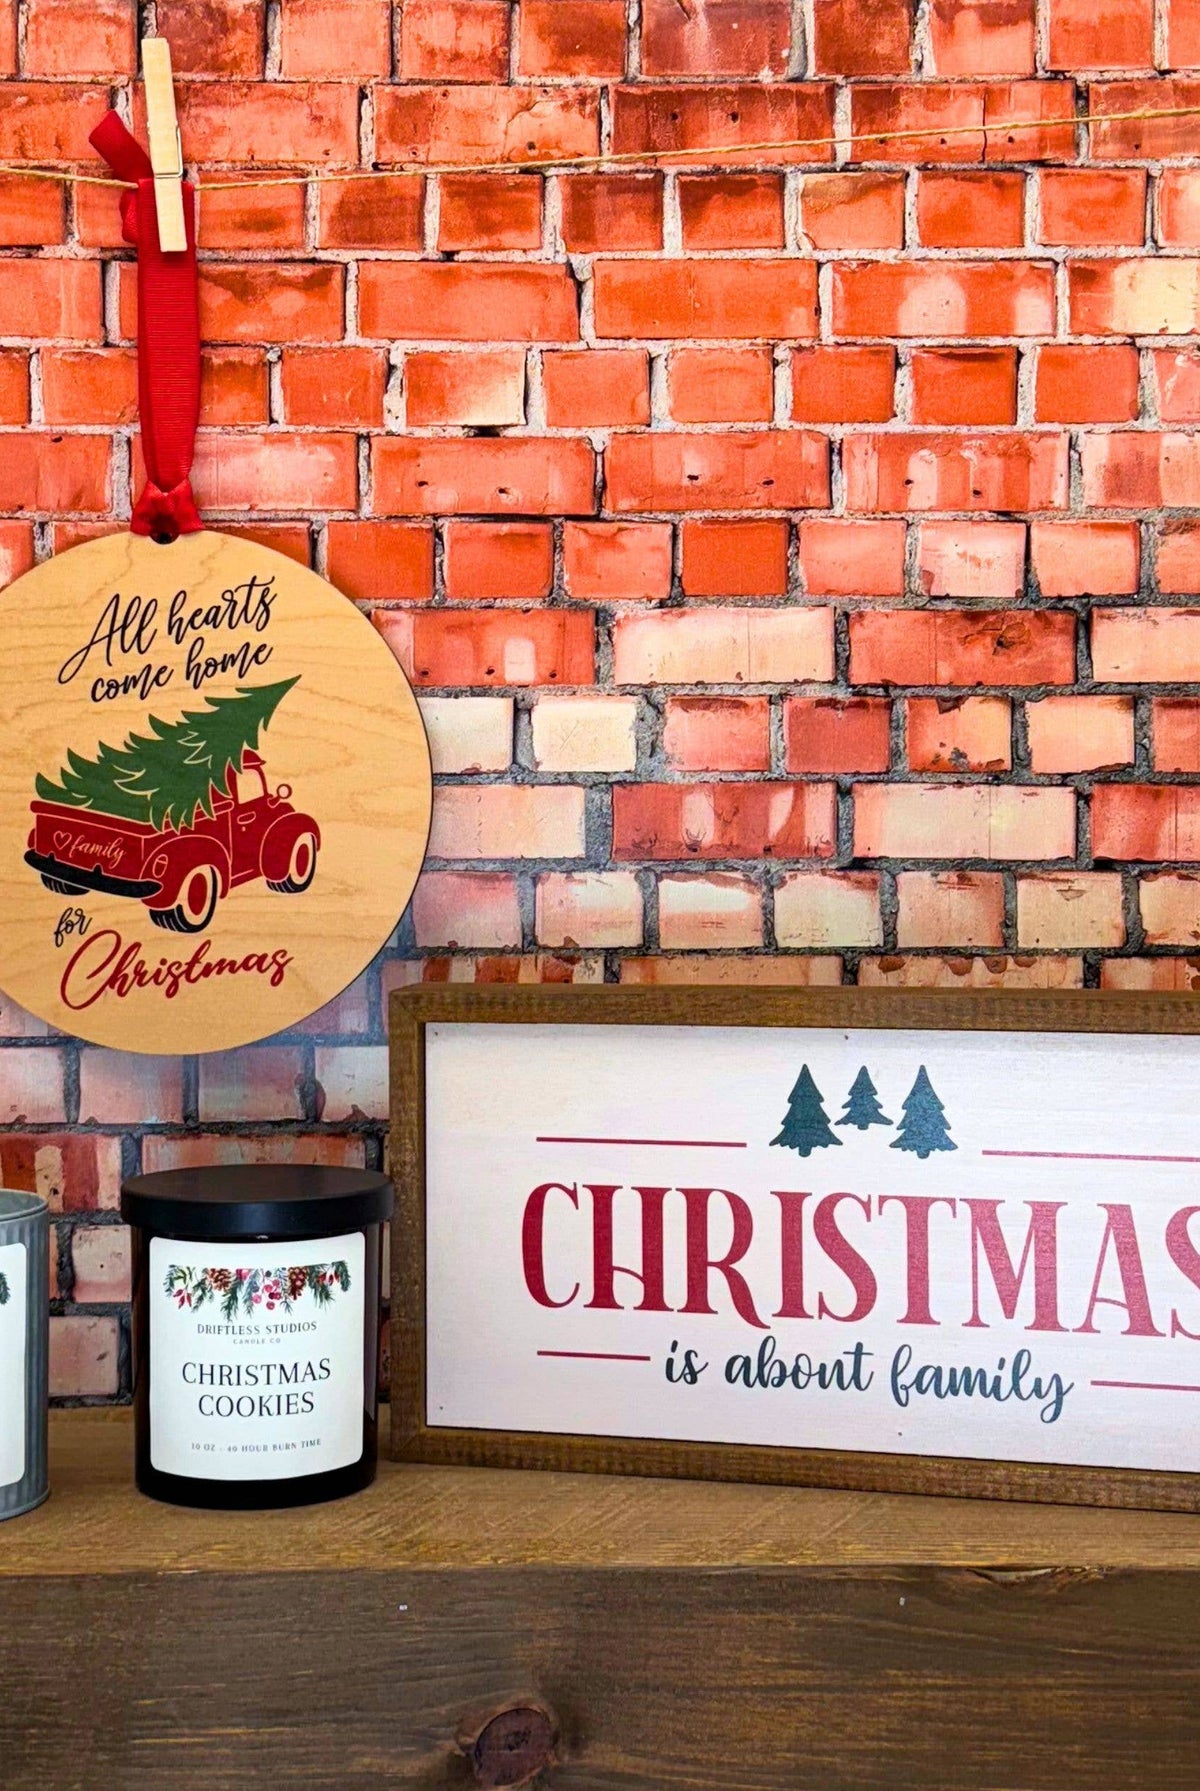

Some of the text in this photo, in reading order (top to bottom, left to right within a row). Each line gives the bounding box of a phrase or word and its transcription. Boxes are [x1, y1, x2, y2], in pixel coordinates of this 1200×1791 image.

[57, 575, 277, 685] All hearts
[90, 636, 274, 702] come home
[68, 834, 126, 869] family
[53, 907, 93, 948] for
[60, 929, 294, 1011] Christmas
[197, 1320, 318, 1335] DRIFTLESS STUDIOS
[181, 1357, 331, 1387] CHRISTMAS
[664, 1335, 1074, 1424] is about family
[198, 1391, 315, 1418] COOKIES
[203, 1443, 216, 1452] OZ
[241, 1444, 269, 1453] HOUR
[272, 1441, 298, 1452] BURN
[301, 1438, 322, 1449] TIME
